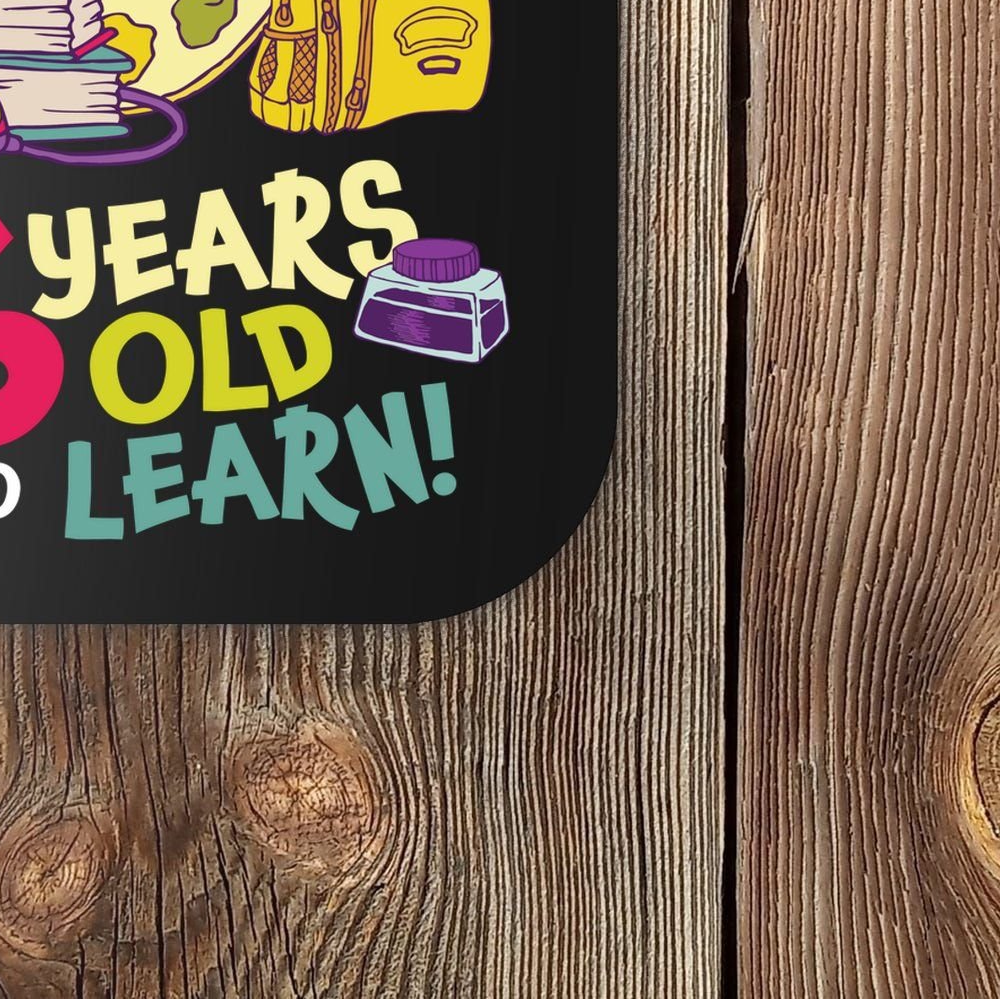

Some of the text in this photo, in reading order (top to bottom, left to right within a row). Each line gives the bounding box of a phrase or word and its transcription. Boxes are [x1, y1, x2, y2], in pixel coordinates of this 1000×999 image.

[28, 160, 419, 320] YEARS
[90, 304, 333, 424] OLD
[65, 382, 456, 540] LEARN!
